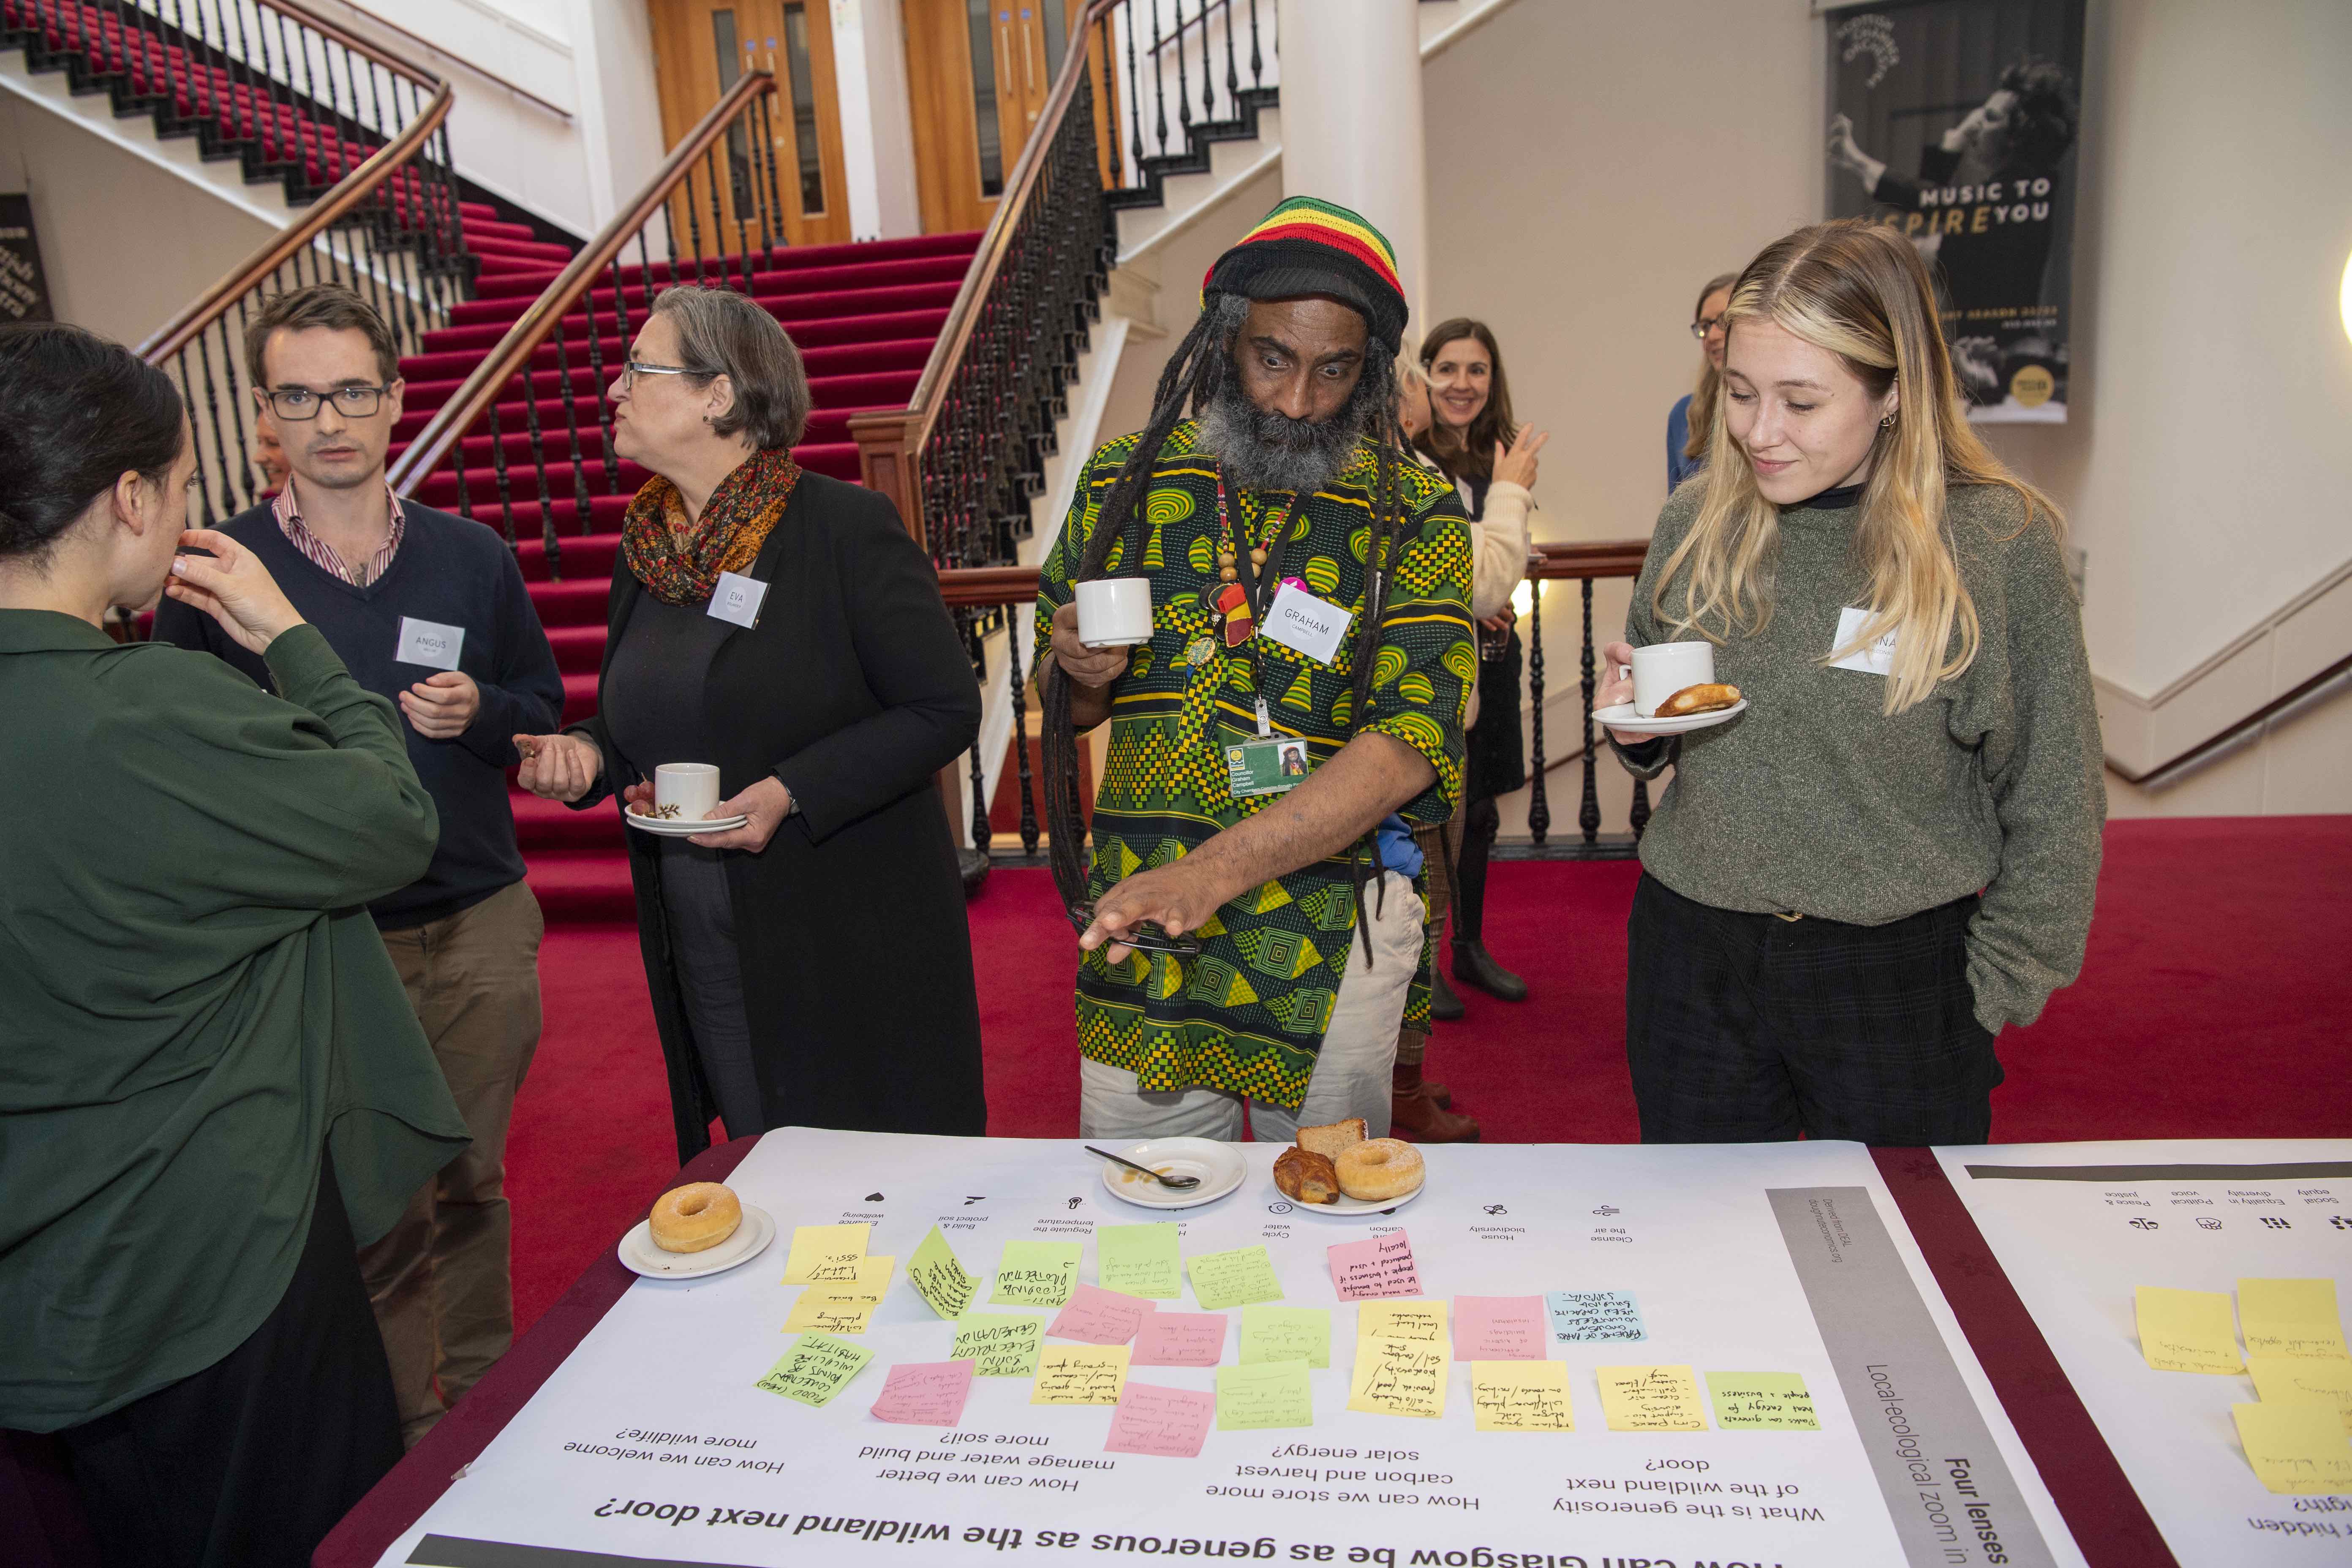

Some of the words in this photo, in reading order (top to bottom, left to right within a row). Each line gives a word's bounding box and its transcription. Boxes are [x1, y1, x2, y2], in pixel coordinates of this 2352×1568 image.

[1920, 182, 2002, 207] MUSIC
[2015, 177, 2050, 199] TO
[1993, 202, 2049, 223] YOU
[730, 591, 743, 603] EVA
[1285, 608, 1329, 634] GRAHAM
[1291, 624, 1313, 637] CAMPBELL
[415, 636, 446, 649] ANGUS
[2227, 1190, 2271, 1198] diversity
[1049, 1226, 1093, 1234] Regulate
[1823, 1199, 1840, 1219] Derived
[1832, 1220, 1843, 1232] from
[1838, 1233, 1852, 1247] DEAL
[1808, 1199, 1843, 1263] doughnuteconomics.org
[1379, 1240, 1407, 1253] locally
[1380, 1250, 1412, 1267] produced
[1350, 1263, 1367, 1272] used
[1391, 1261, 1414, 1274] people
[1339, 1275, 1346, 1284] if
[1349, 1271, 1381, 1281] business
[1387, 1278, 1405, 1286] used
[1407, 1276, 1416, 1284] be
[1342, 1284, 1370, 1293] benefit
[978, 1365, 1029, 1376] WATER
[1782, 1391, 1810, 1400] people
[1748, 1399, 1782, 1412] energy
[1792, 1405, 1813, 1414] heat
[1723, 1414, 1762, 1423] generate
[1788, 1418, 1815, 1426] Parks
[615, 1428, 698, 1446] wildlife?
[703, 1436, 758, 1450] more
[939, 1432, 989, 1445] soil?
[994, 1435, 1049, 1447] more
[563, 1441, 654, 1461] welcome
[858, 1446, 912, 1462] build
[915, 1450, 956, 1463] and
[1271, 1444, 1358, 1460] energy?
[1364, 1449, 1420, 1463] solar
[659, 1453, 689, 1465] we
[694, 1456, 732, 1467] can
[960, 1453, 1020, 1465] water
[1027, 1455, 1116, 1470] manage
[1645, 1458, 1710, 1473] door?
[1866, 1364, 1941, 1486] Local-ecological
[1919, 1492, 1958, 1542] zoom
[1944, 1549, 1969, 1564] in
[735, 1460, 785, 1474] How
[1235, 1465, 1318, 1482] harvest
[876, 1468, 941, 1484] better
[946, 1473, 976, 1484] we
[984, 1474, 1023, 1487] can
[1326, 1469, 1367, 1482] and
[1375, 1471, 1454, 1486] carbon
[1028, 1477, 1079, 1492] How
[1206, 1485, 1265, 1498] more
[1566, 1478, 1616, 1492] next
[1625, 1479, 1723, 1495] wildland
[1729, 1484, 1769, 1497] the
[1775, 1484, 1799, 1498] of
[1272, 1489, 1331, 1503] store
[1337, 1492, 1370, 1504] we
[1378, 1493, 1420, 1505] can
[1427, 1495, 1480, 1511] How
[593, 1497, 700, 1527] door?
[1553, 1497, 1677, 1515] generosity
[1686, 1504, 1726, 1518] the
[1732, 1505, 1752, 1519] is
[1944, 1458, 1979, 1497] Four
[1964, 1503, 2009, 1565] lenses
[706, 1508, 790, 1530] next
[1759, 1506, 1825, 1522] What
[793, 1515, 951, 1545] wildland
[2247, 1517, 2341, 1539] hidden
[963, 1527, 1024, 1552] the
[1035, 1530, 1081, 1550] as
[1091, 1534, 1276, 1561] generous
[1289, 1544, 1335, 1563] as
[1348, 1546, 1396, 1568] be
